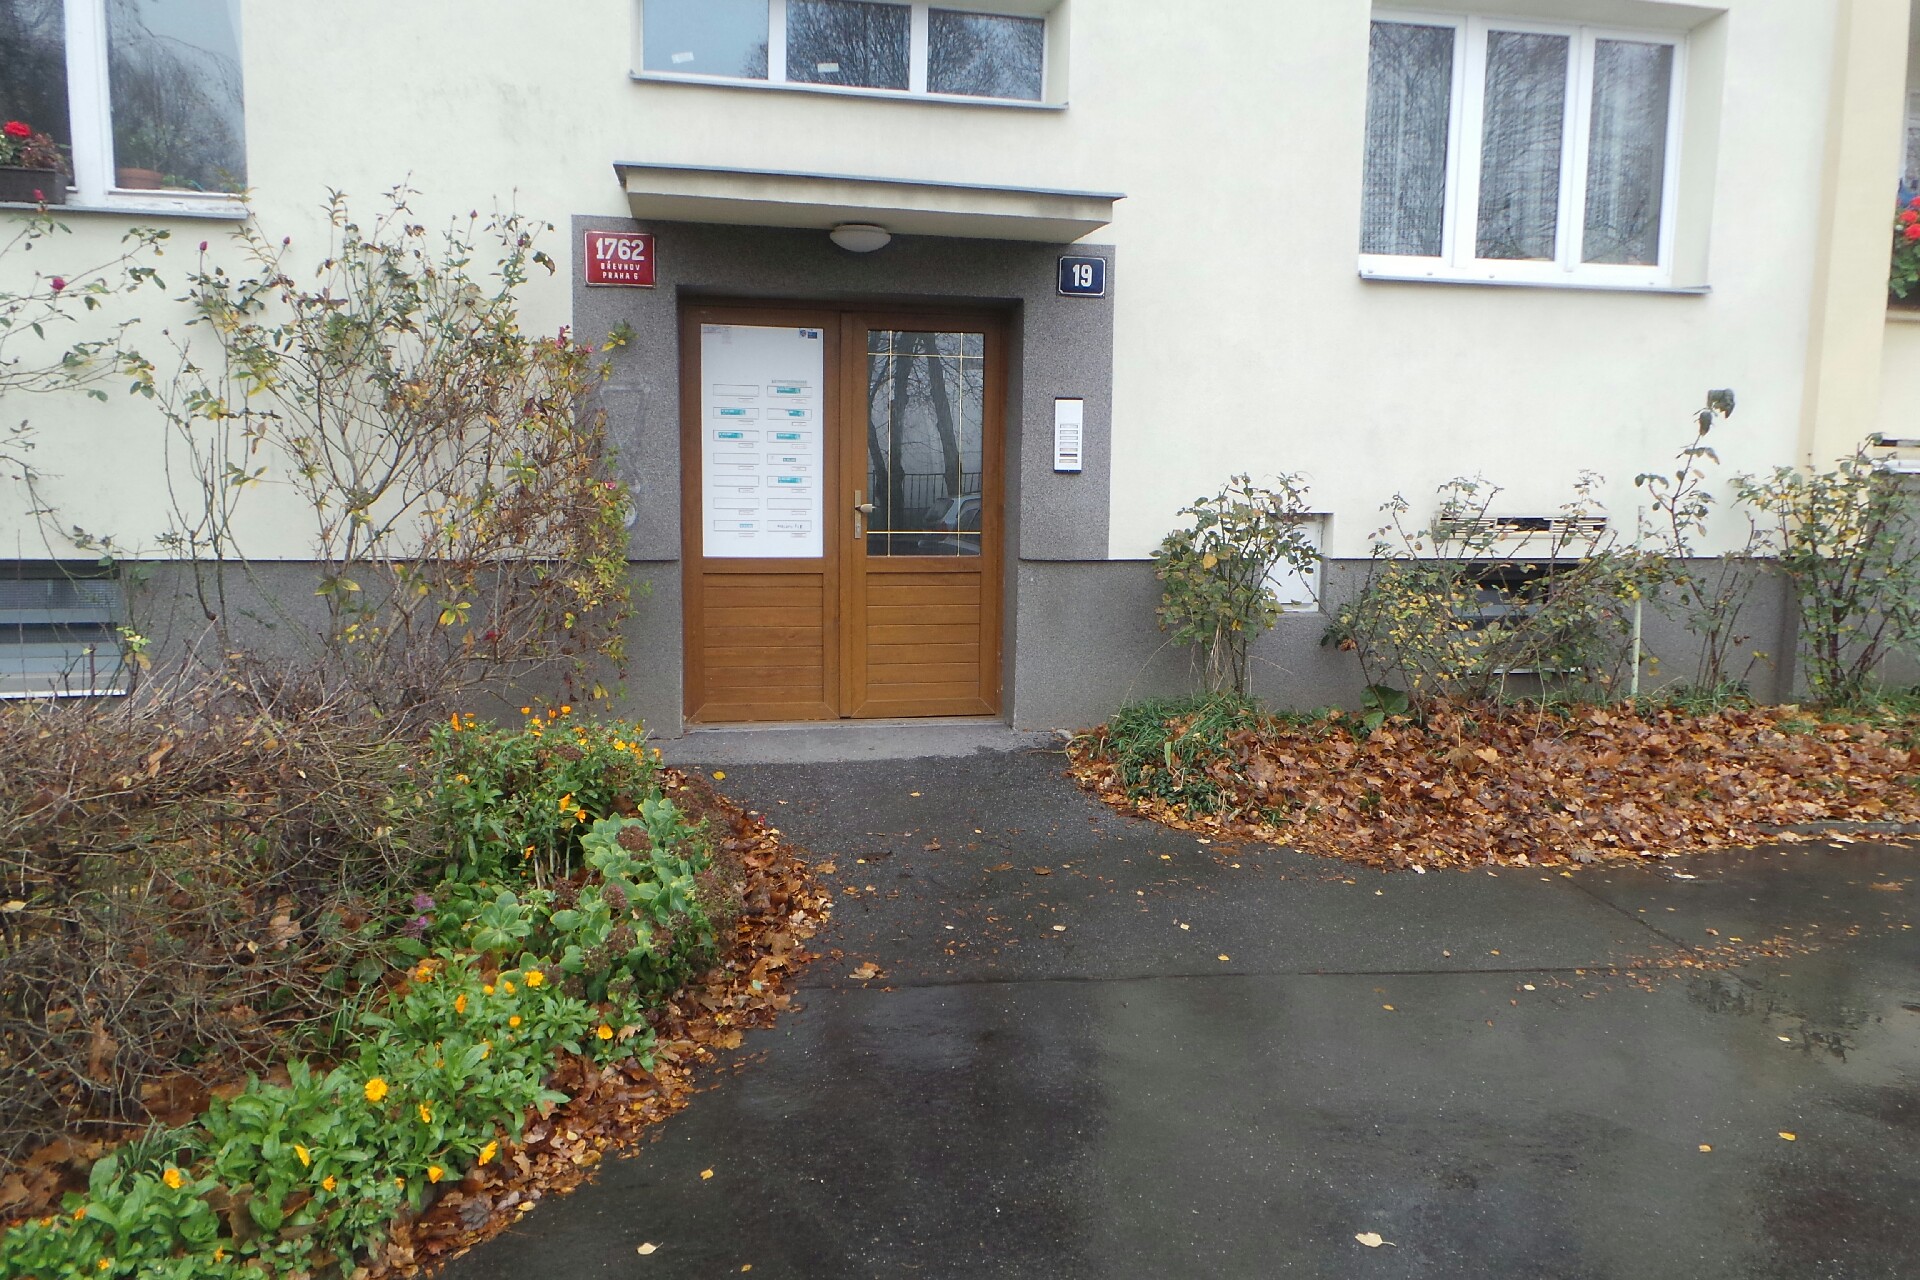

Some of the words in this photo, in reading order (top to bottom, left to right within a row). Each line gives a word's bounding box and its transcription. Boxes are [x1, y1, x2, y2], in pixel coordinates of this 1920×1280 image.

[596, 237, 645, 261] 1762
[600, 261, 641, 271] BŘEVNOV
[602, 271, 631, 280] PRAHA
[1072, 264, 1093, 287] 19
